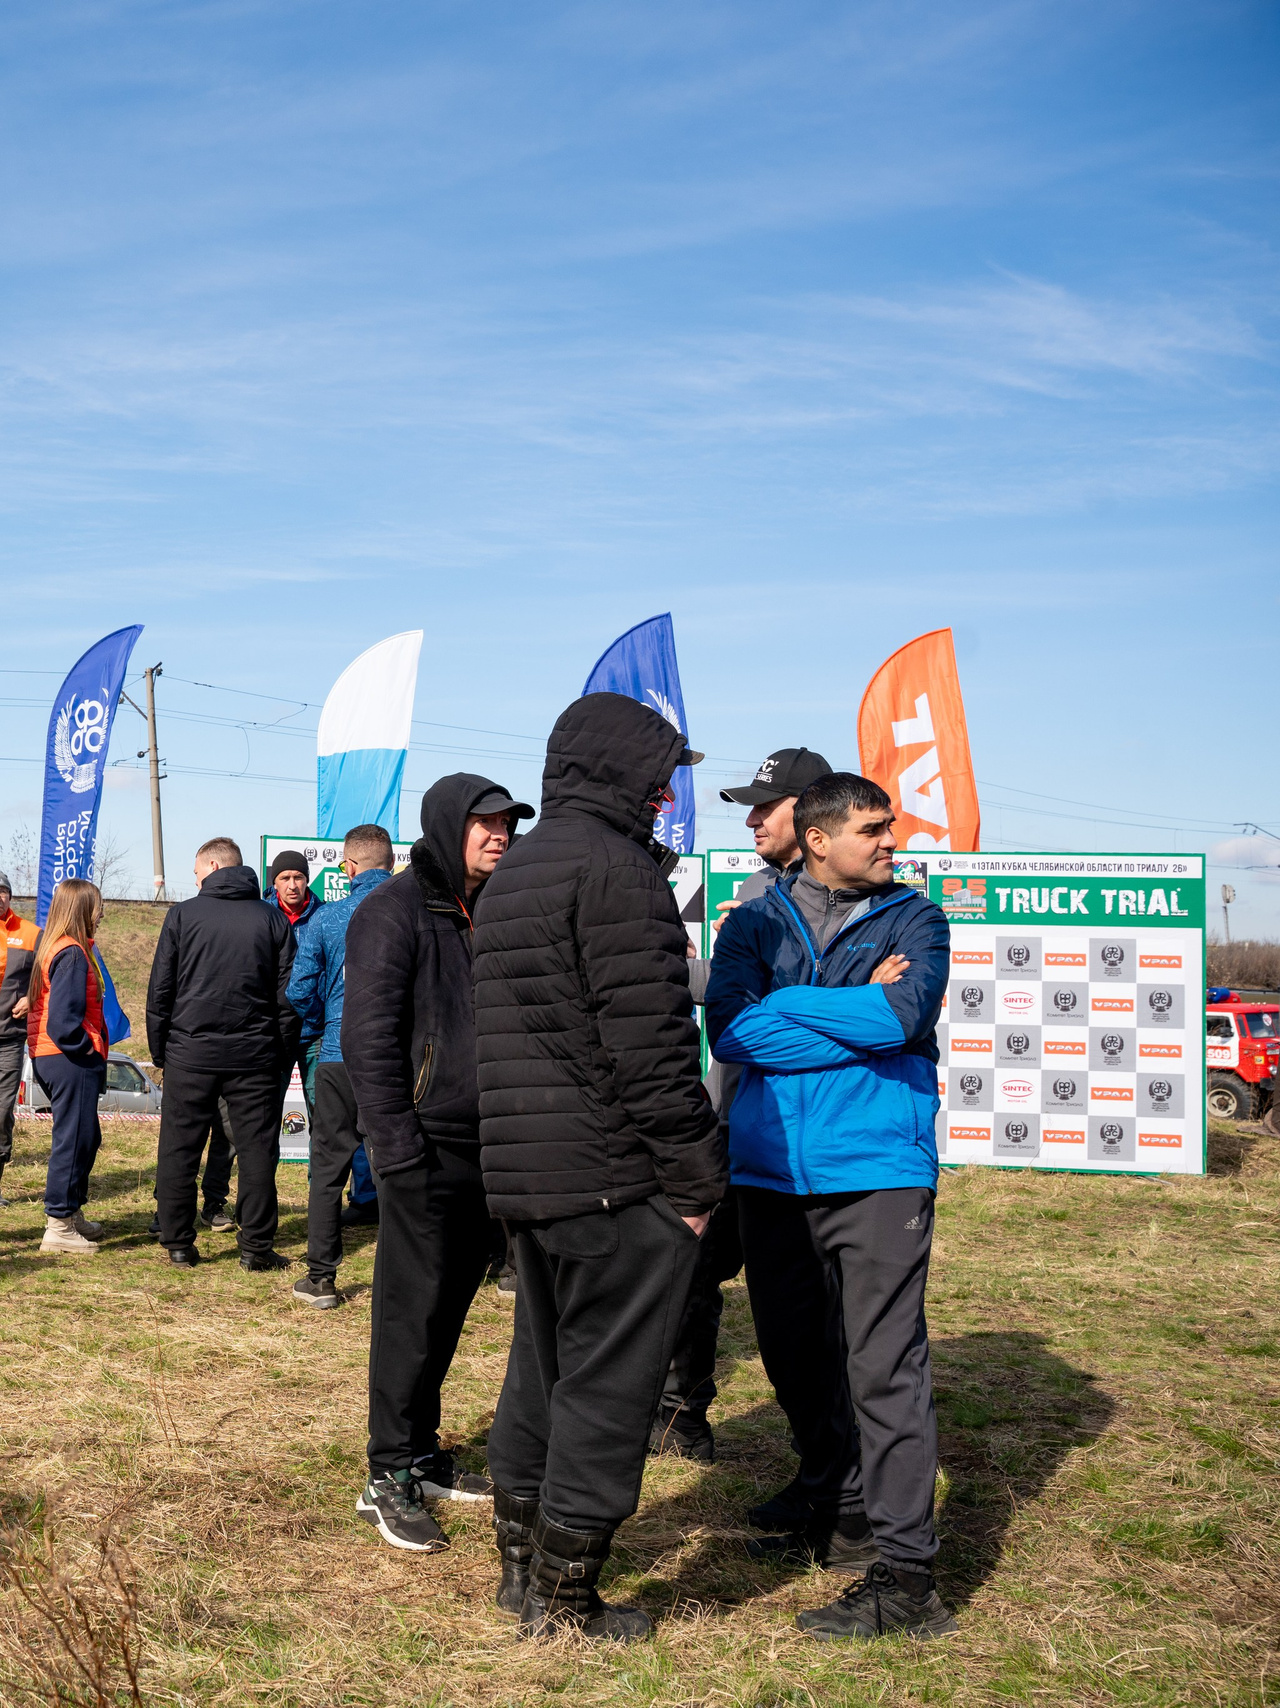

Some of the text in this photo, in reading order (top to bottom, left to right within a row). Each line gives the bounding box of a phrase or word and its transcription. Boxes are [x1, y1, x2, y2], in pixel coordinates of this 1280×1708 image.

[1002, 861, 1028, 871] КУБКА
[1029, 862, 1085, 872] ЧЕЛЯБИНСКОЙ
[1086, 862, 1122, 872] ОБЛАСТИ
[1124, 863, 1135, 872] ПО
[1137, 863, 1168, 873] ТРИАЛУ
[324, 872, 351, 889] RF
[942, 878, 987, 895] 85
[324, 889, 351, 902] RUS
[995, 887, 1188, 916] TRUCK TRIAL
[945, 912, 987, 920] УРАЛ
[1207, 1049, 1231, 1059] 509
